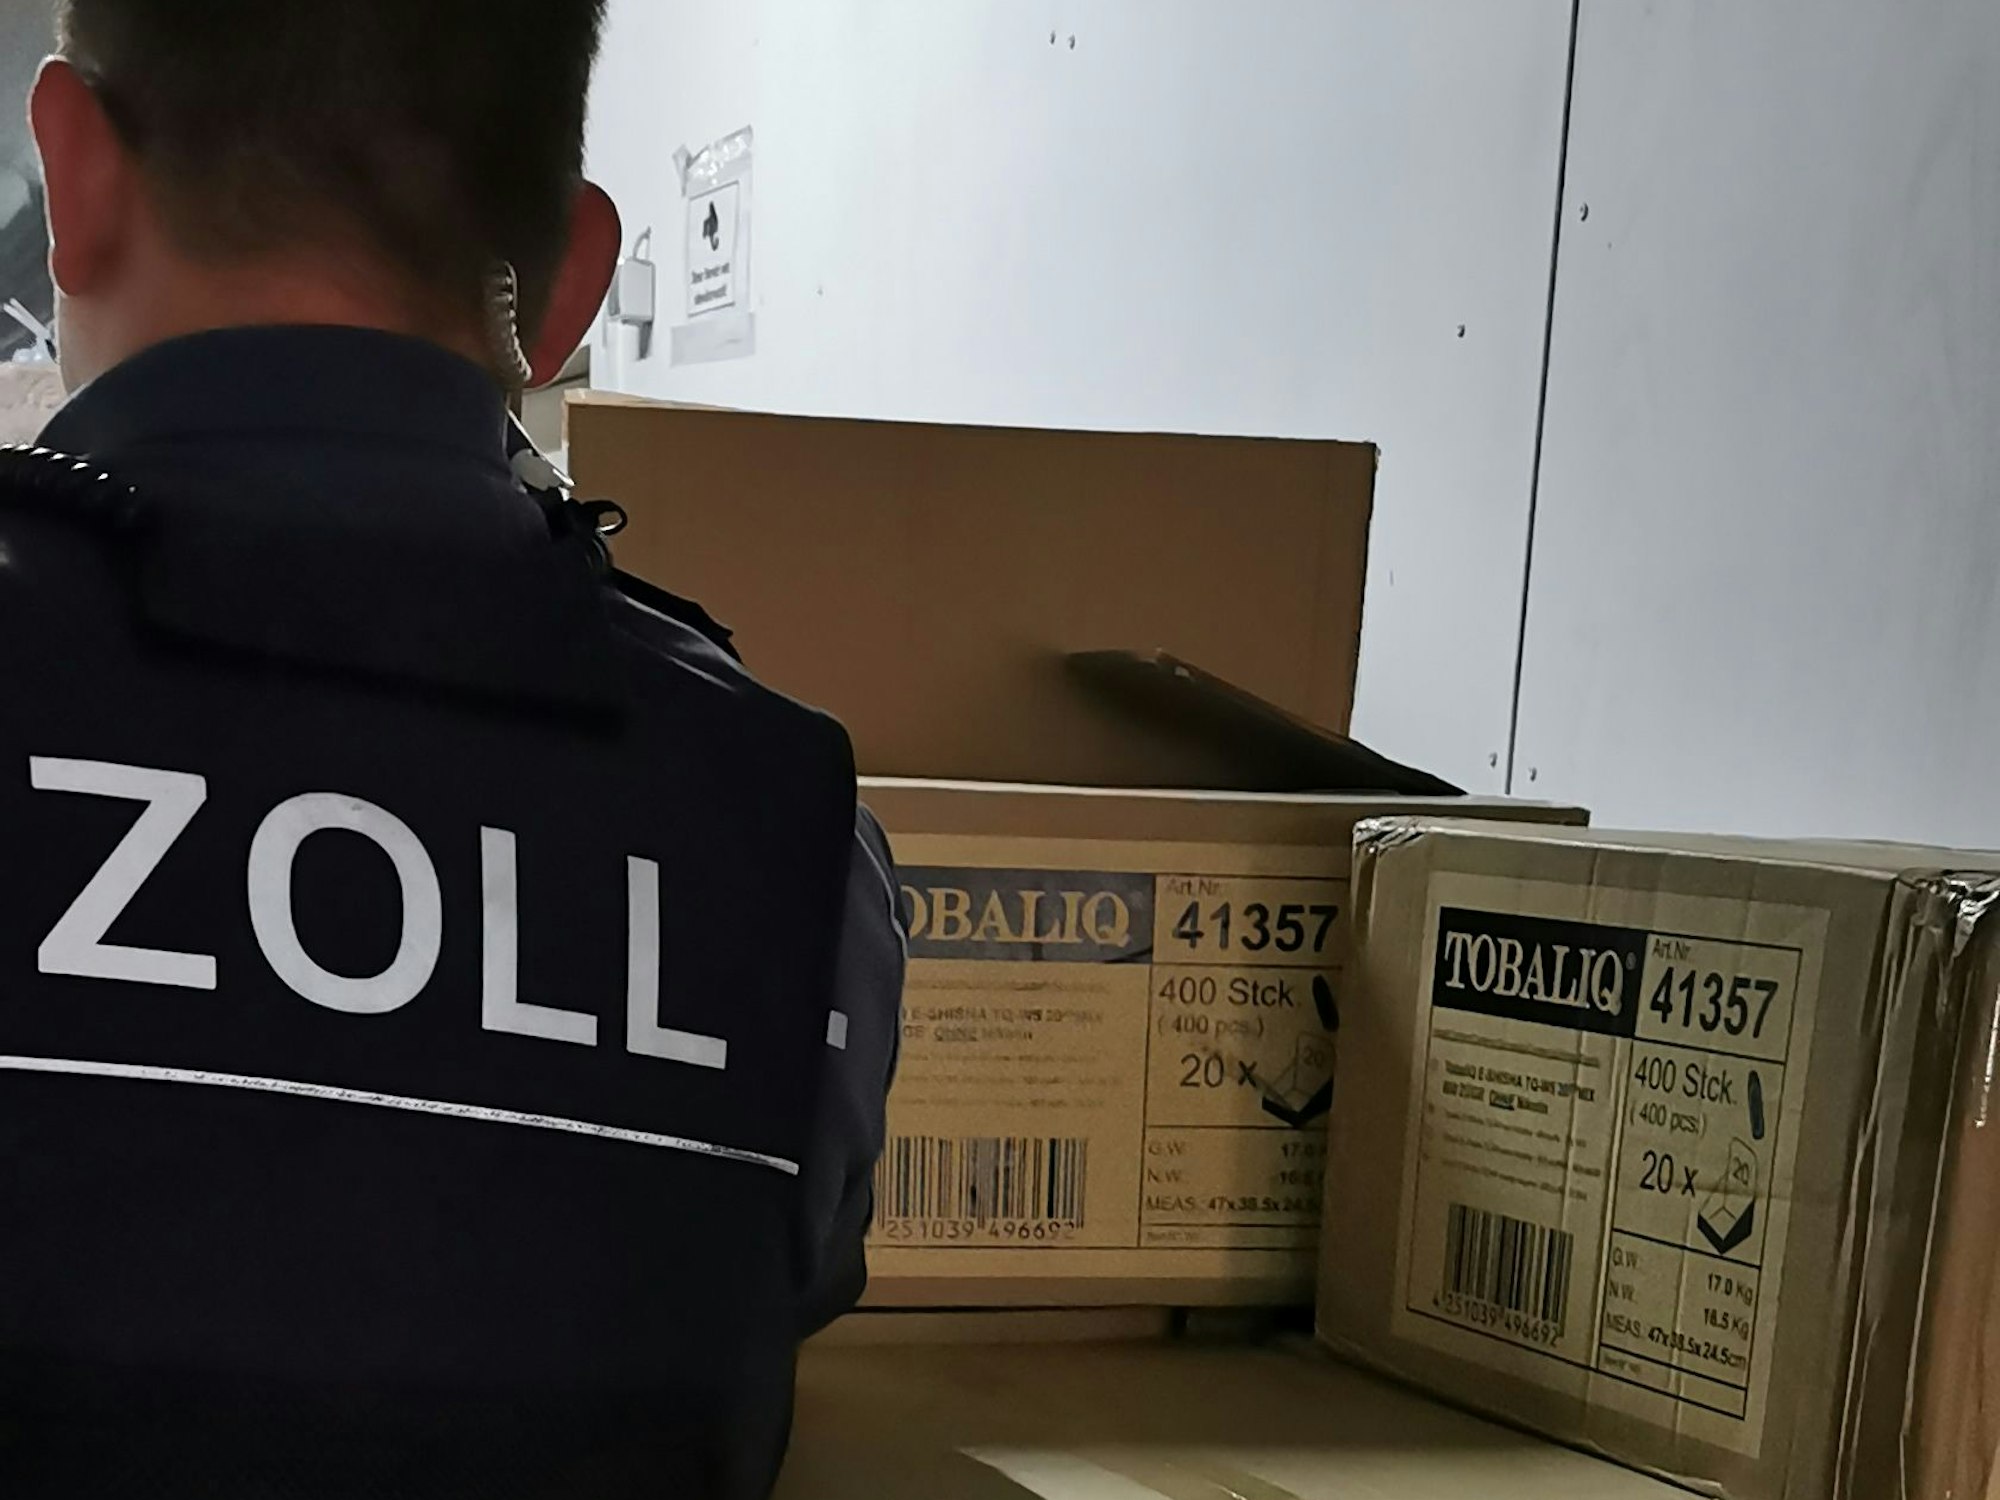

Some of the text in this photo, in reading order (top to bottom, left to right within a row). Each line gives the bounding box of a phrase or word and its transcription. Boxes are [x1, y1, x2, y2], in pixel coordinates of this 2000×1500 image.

[29, 755, 728, 1070] ZOLL
[901, 885, 1132, 948] OBALIQ
[1172, 900, 1340, 952] 41357
[1159, 976, 1217, 1006] 400
[1444, 930, 1624, 1017] TOBALIQ
[1650, 966, 1779, 1039] 41357
[1179, 1052, 1258, 1088] 20 x
[1634, 1056, 1677, 1093] 400
[1639, 1150, 1675, 1194] 20
[1681, 1166, 1699, 1198] x
[885, 1219, 975, 1240] 251039
